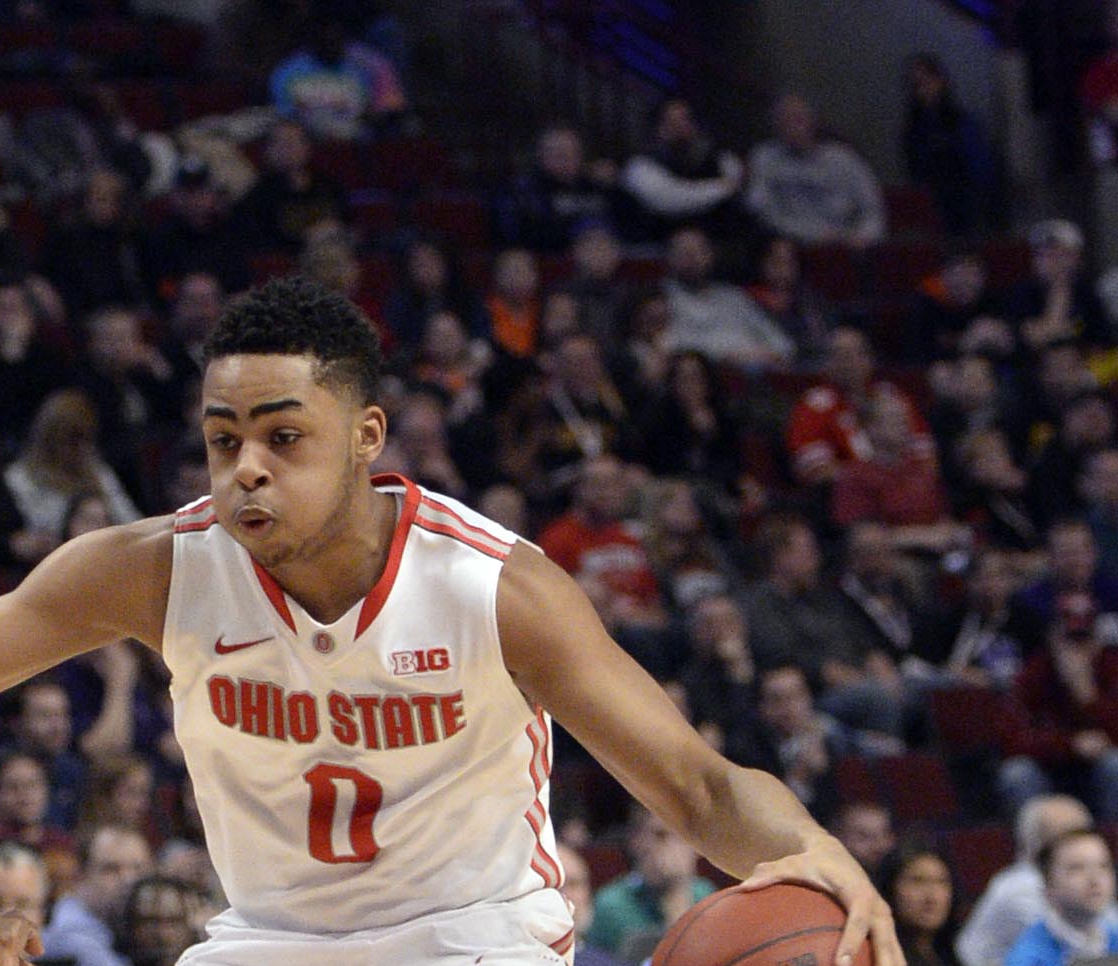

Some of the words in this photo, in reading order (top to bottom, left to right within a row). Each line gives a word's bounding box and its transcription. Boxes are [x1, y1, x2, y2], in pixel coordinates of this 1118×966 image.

[207, 674, 321, 745] OHIO
[327, 689, 467, 751] STATE
[303, 760, 383, 865] 0
